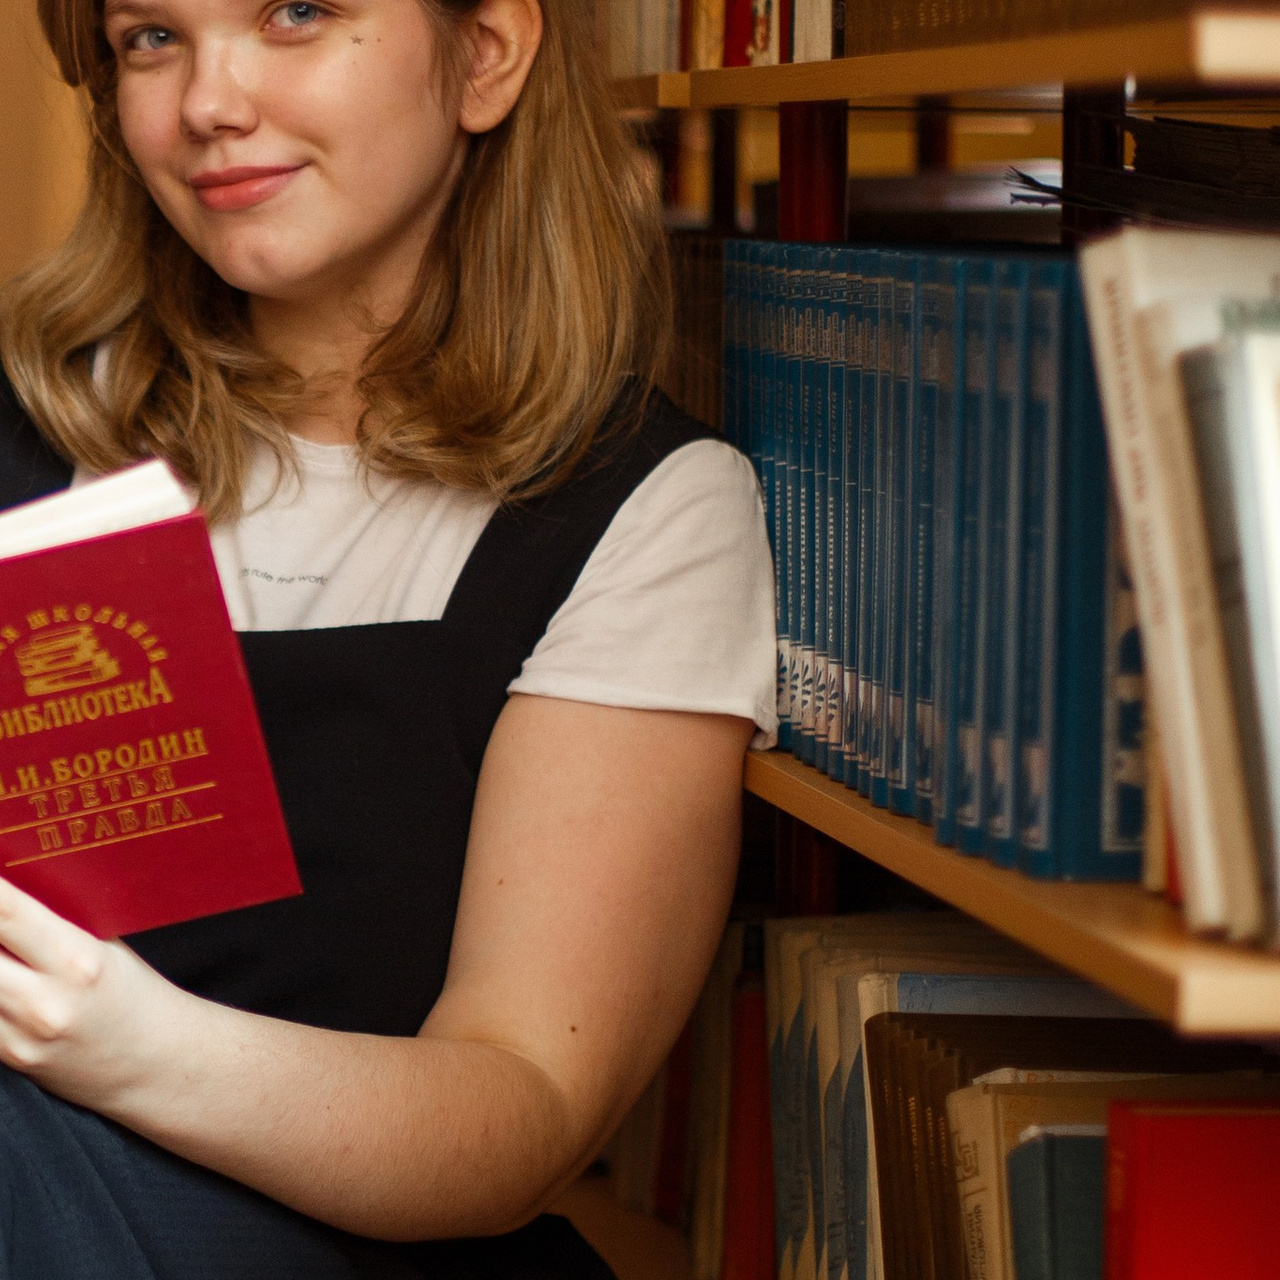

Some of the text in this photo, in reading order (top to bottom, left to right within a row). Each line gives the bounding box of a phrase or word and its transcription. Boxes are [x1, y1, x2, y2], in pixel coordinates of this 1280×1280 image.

[26, 603, 169, 663] ШКОЛЬНАЯ
[28, 767, 177, 819] ТРЕТЬЯ
[37, 798, 193, 852] ПРАВДА
